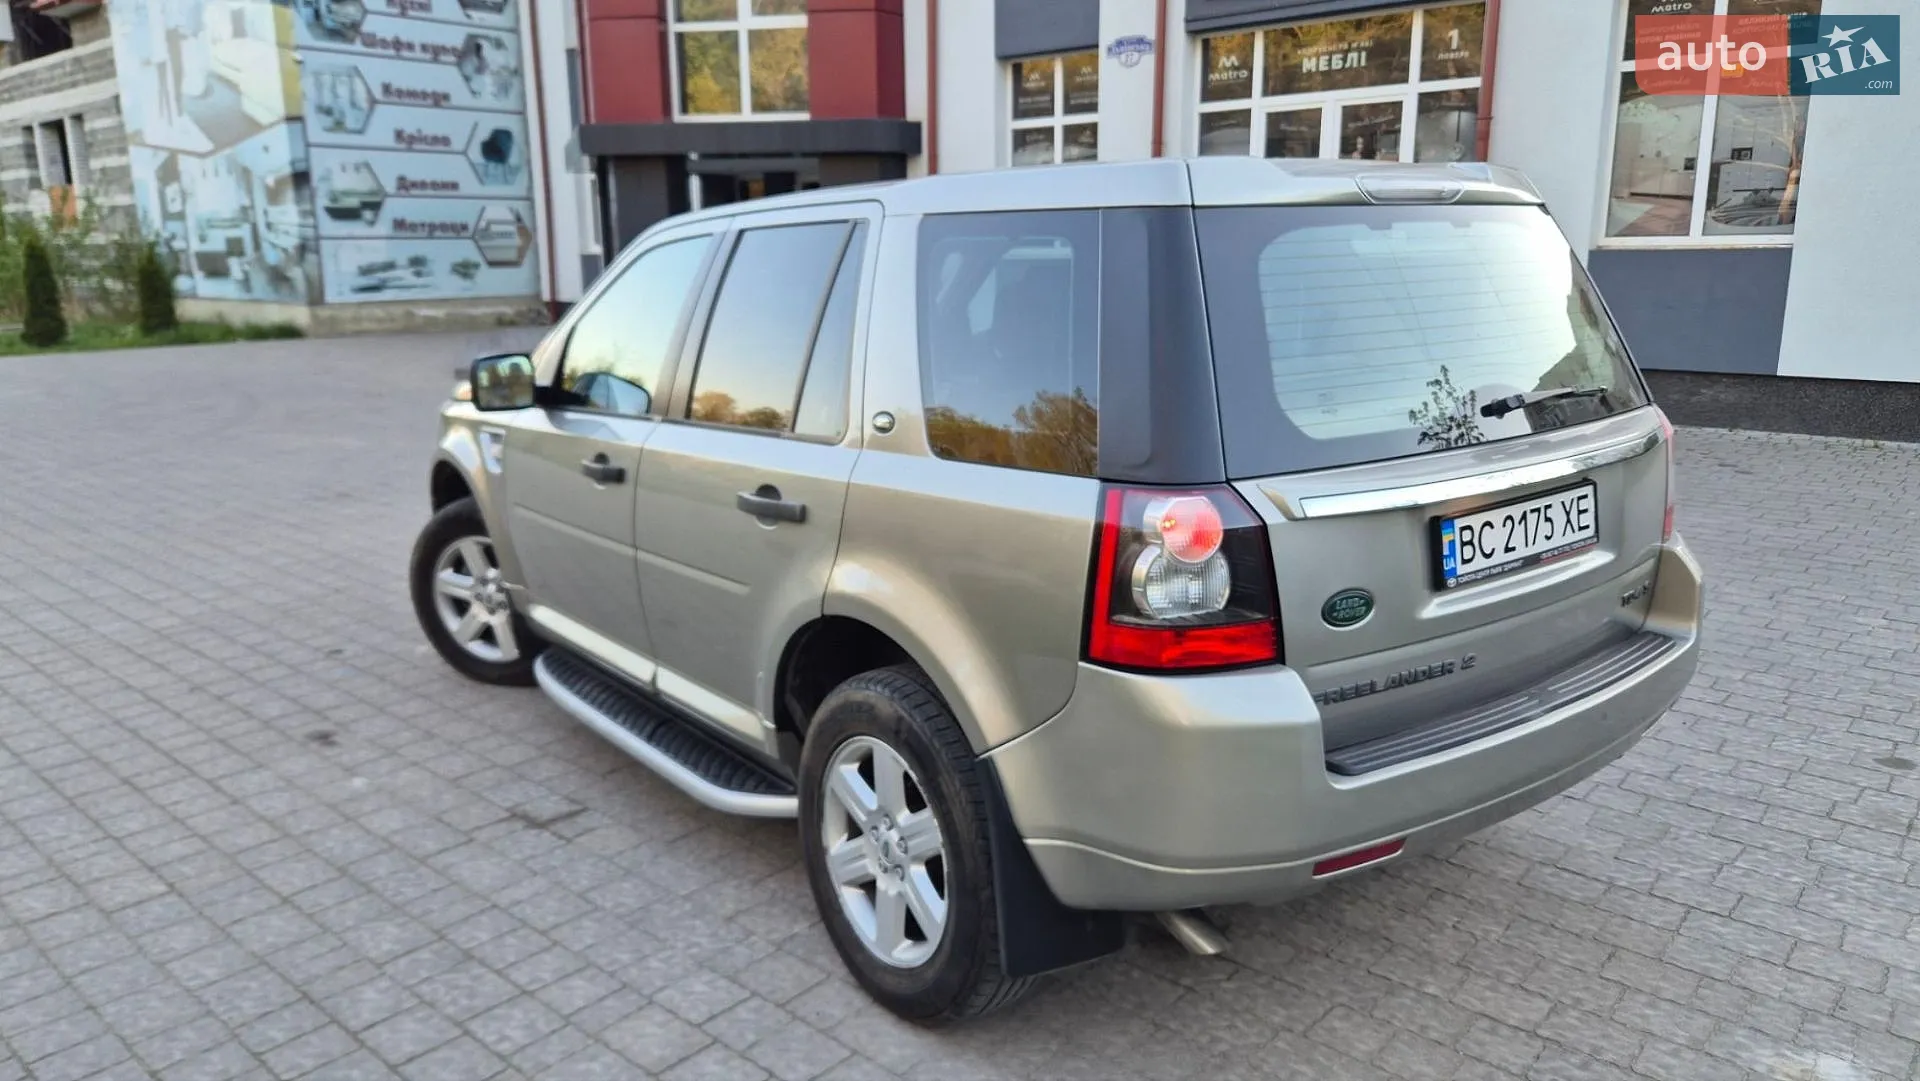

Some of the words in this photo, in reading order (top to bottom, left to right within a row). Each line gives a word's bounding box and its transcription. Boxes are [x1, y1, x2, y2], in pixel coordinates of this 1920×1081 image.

[1448, 28, 1459, 49] 1
[1302, 51, 1367, 73] МЕБЛІ
[381, 81, 451, 106] Комоди
[396, 174, 459, 193] Дивани
[392, 217, 469, 237] Матраци
[1459, 520, 1496, 565] BC
[1502, 503, 1554, 553] 2175
[1561, 494, 1590, 538] XE
[1443, 557, 1456, 570] UA
[1311, 659, 1457, 705] FREELANDER
[1460, 652, 1477, 670] 2
